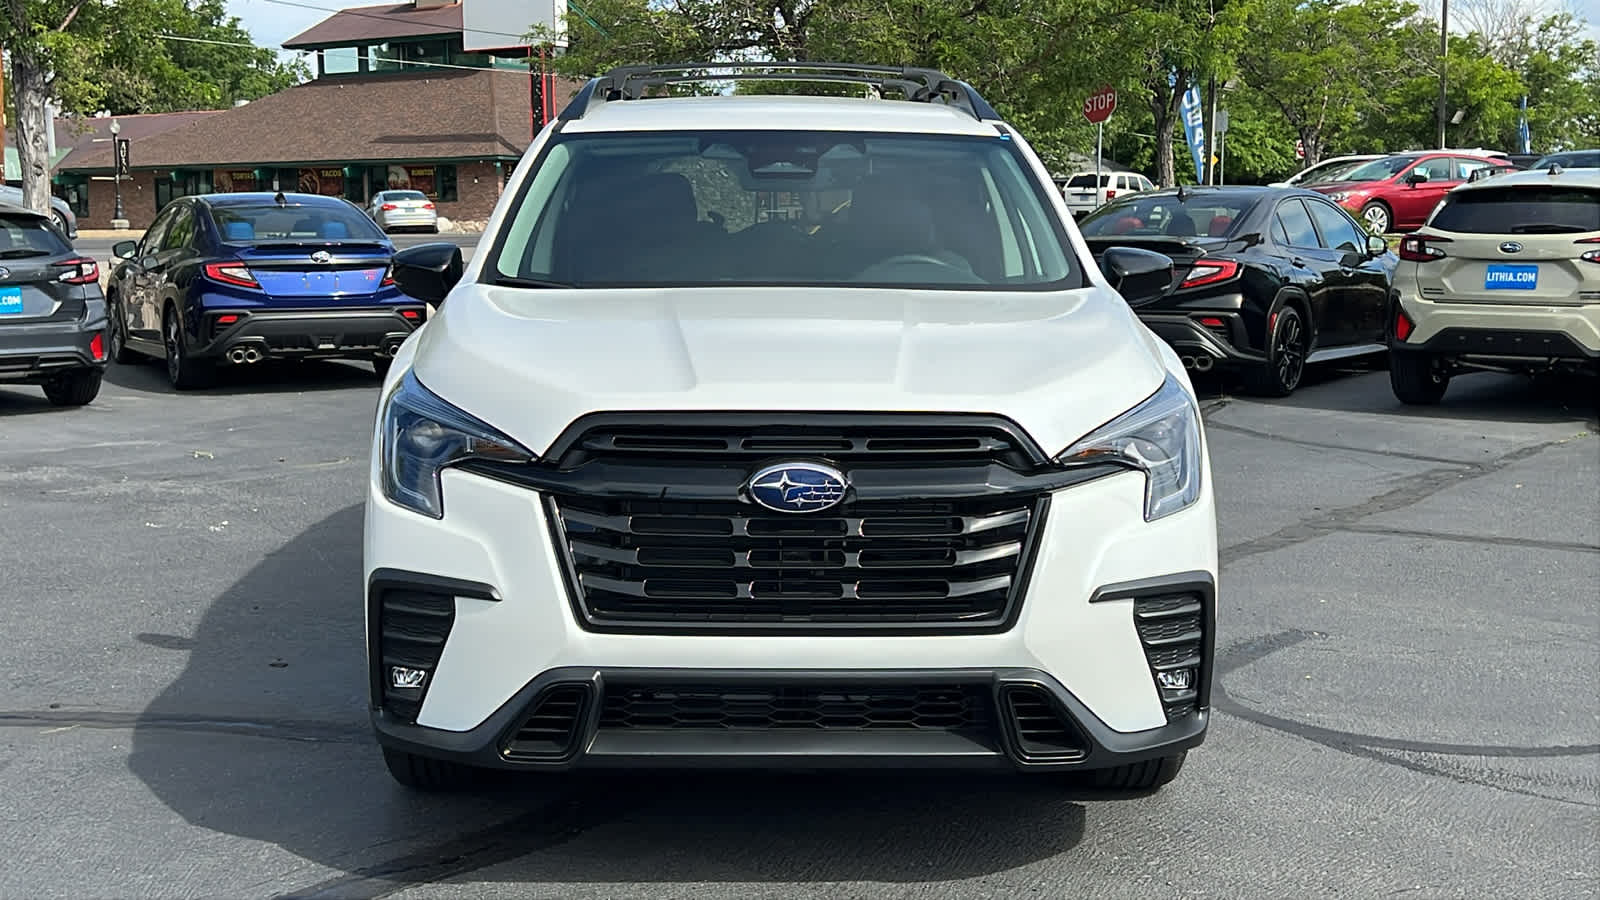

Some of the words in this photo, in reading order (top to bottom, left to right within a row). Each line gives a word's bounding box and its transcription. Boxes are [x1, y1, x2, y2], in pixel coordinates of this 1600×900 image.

[1084, 93, 1114, 113] STOP
[321, 169, 342, 177] TACOS
[1487, 271, 1536, 282] LITHIA.COM
